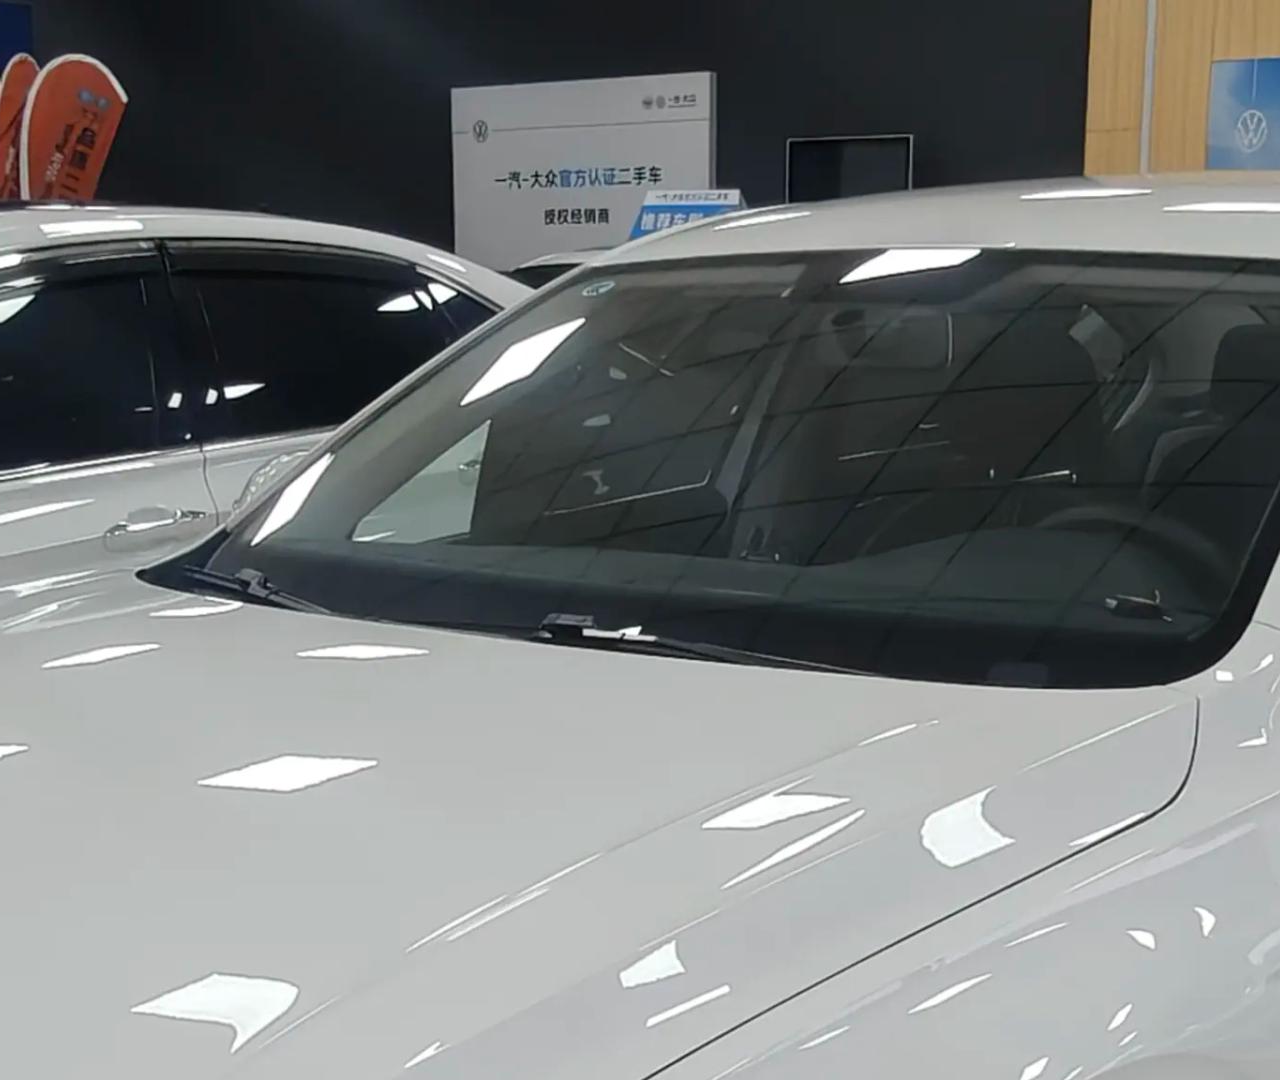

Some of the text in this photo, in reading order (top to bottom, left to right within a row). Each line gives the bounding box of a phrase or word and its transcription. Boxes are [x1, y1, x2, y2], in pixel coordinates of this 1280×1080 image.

[494, 166, 663, 189] 一汽-大众官方认证二手车
[543, 207, 610, 225] 授权经销商
